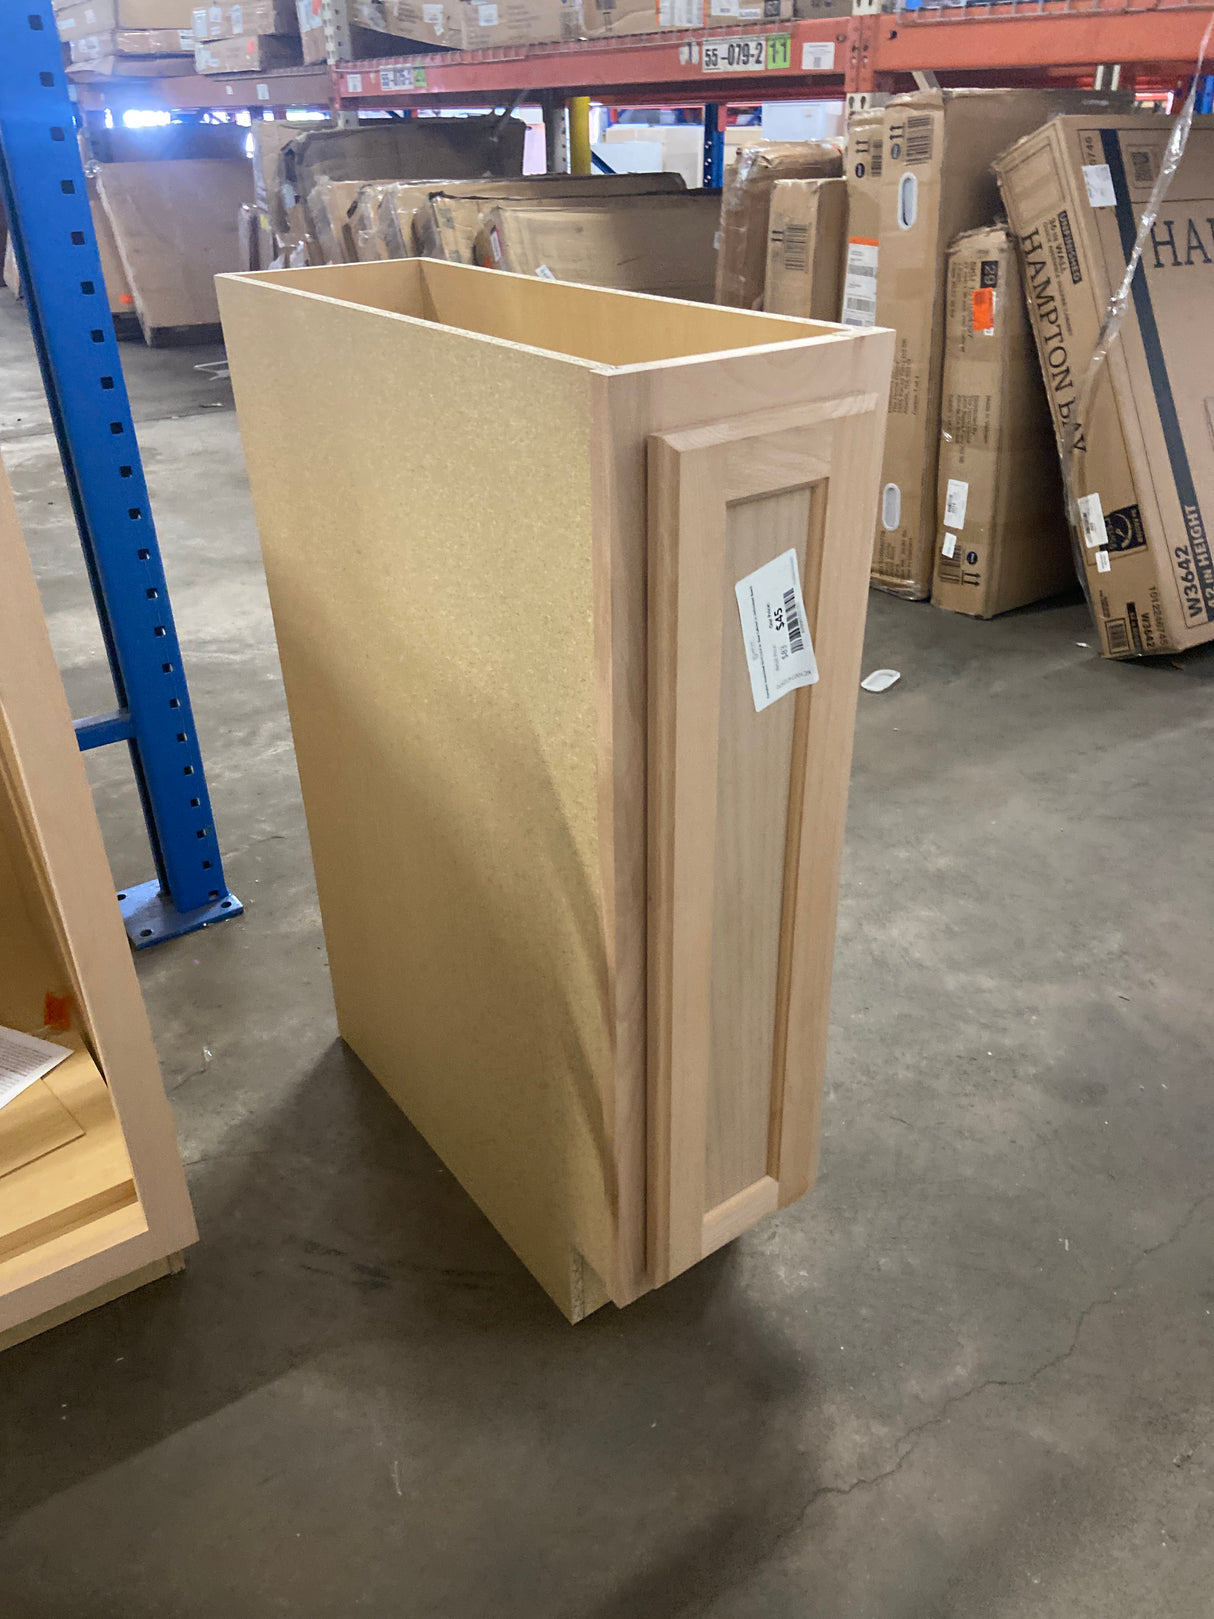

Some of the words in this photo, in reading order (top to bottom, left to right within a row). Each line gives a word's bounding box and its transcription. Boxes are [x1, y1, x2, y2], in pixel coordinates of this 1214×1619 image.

[1021, 228, 1073, 392] HAMPTON
[1185, 505, 1210, 567] HEIGHT
[1174, 545, 1203, 618] W3642
[774, 607, 786, 632] $45
[1141, 612, 1156, 648] W3642
